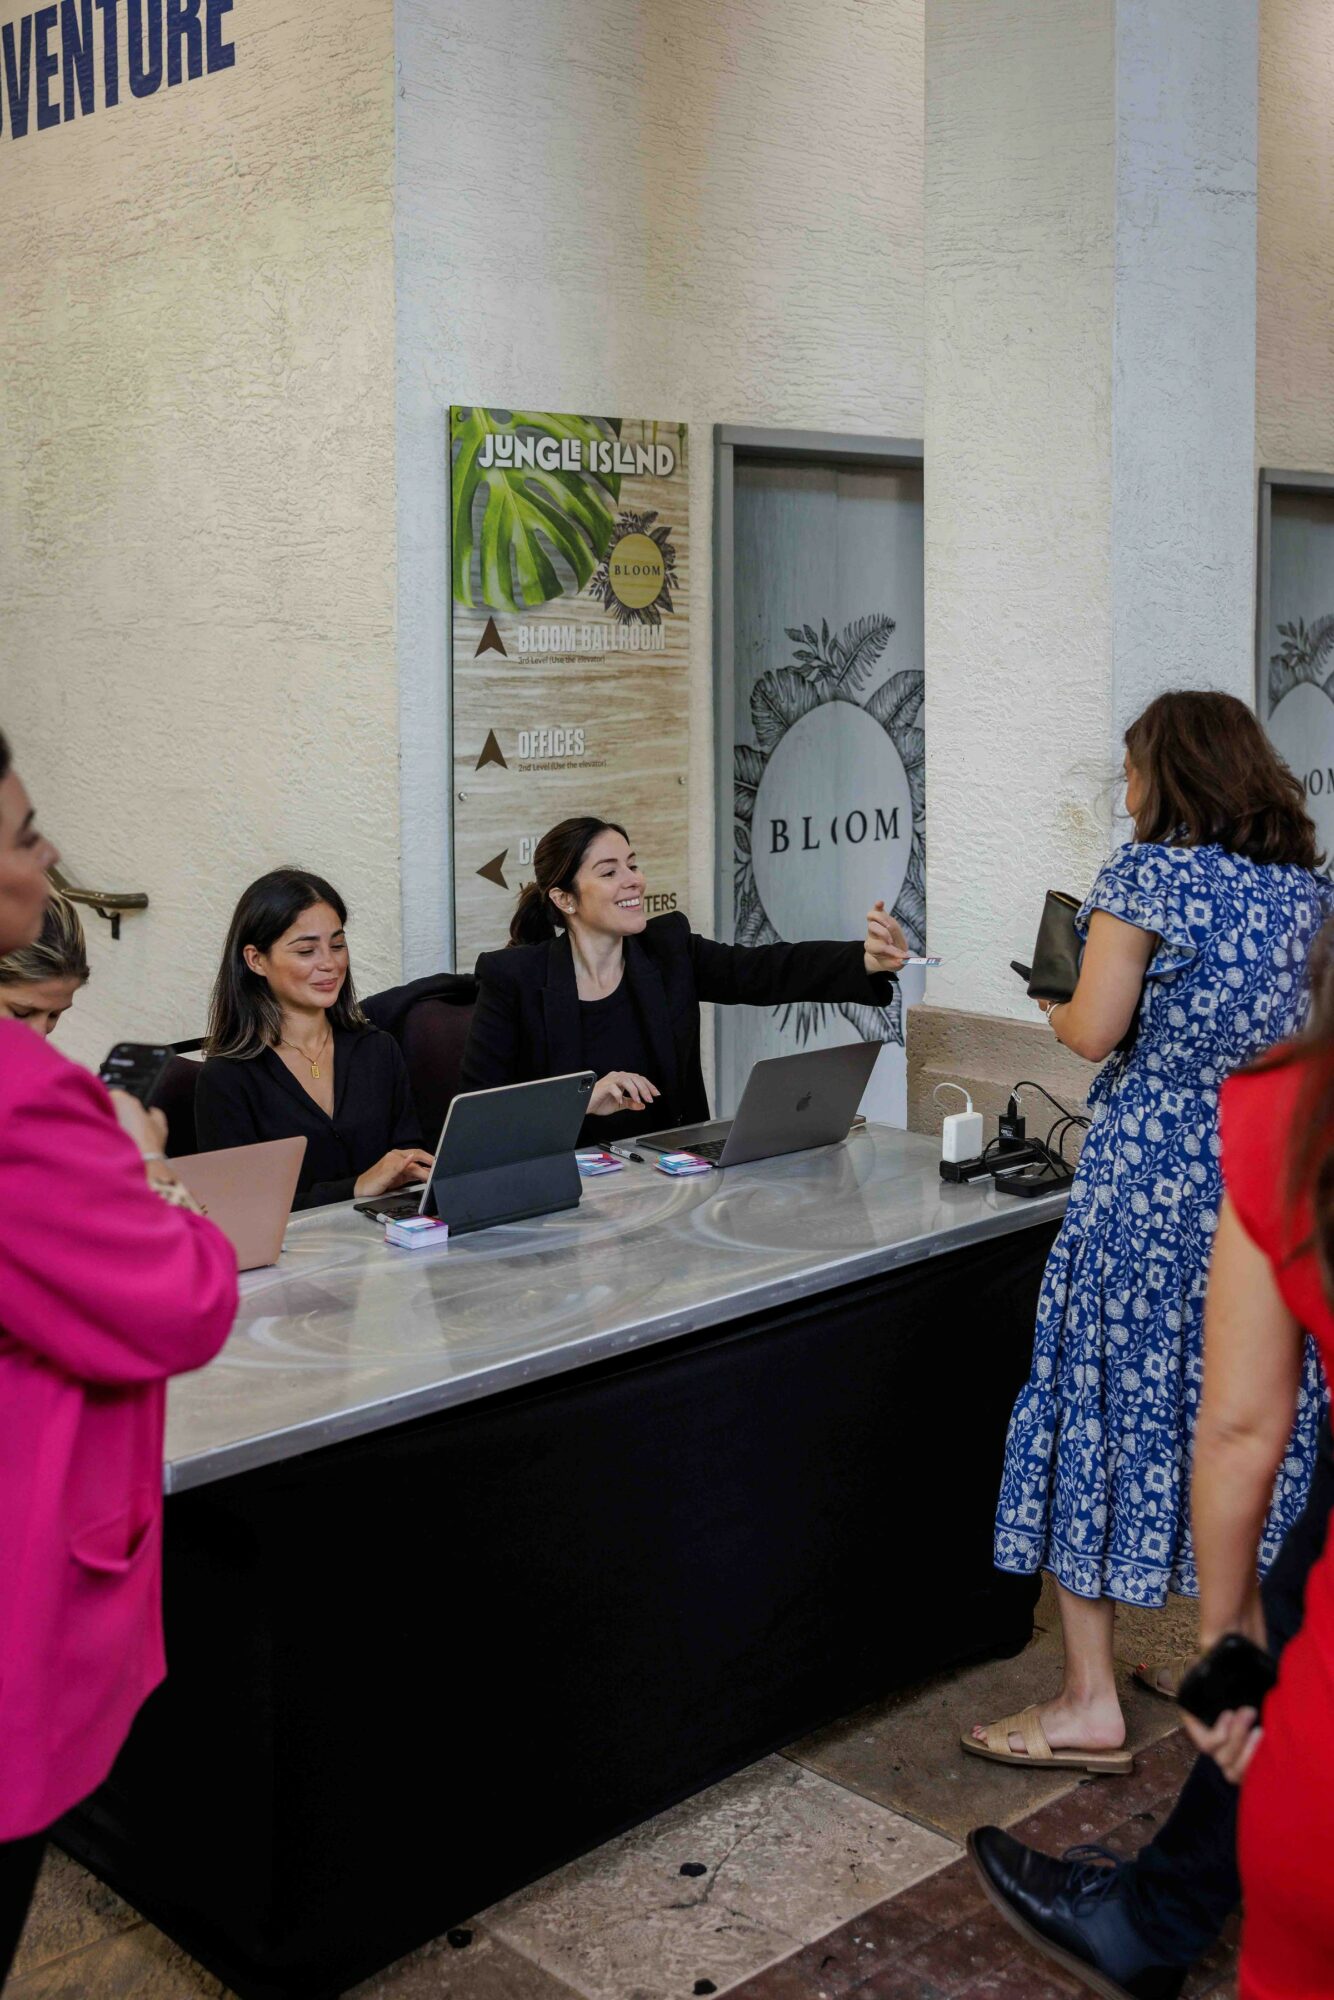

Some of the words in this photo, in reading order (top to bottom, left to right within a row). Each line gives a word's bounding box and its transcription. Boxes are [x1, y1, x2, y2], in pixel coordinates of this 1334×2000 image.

[0, 0, 235, 140] VENTURE
[478, 433, 582, 472] JUNGLE
[589, 440, 675, 476] ISLAND
[614, 564, 661, 576] BLOOM
[518, 625, 577, 653] BLOOM
[581, 623, 665, 651] BALLROOM
[518, 728, 585, 760] OFFICES
[518, 763, 532, 773] 2nd
[532, 762, 550, 772] Level
[551, 761, 566, 771] (Use
[566, 760, 577, 769] the
[578, 759, 607, 769] elevator)
[642, 892, 677, 913] TERS
